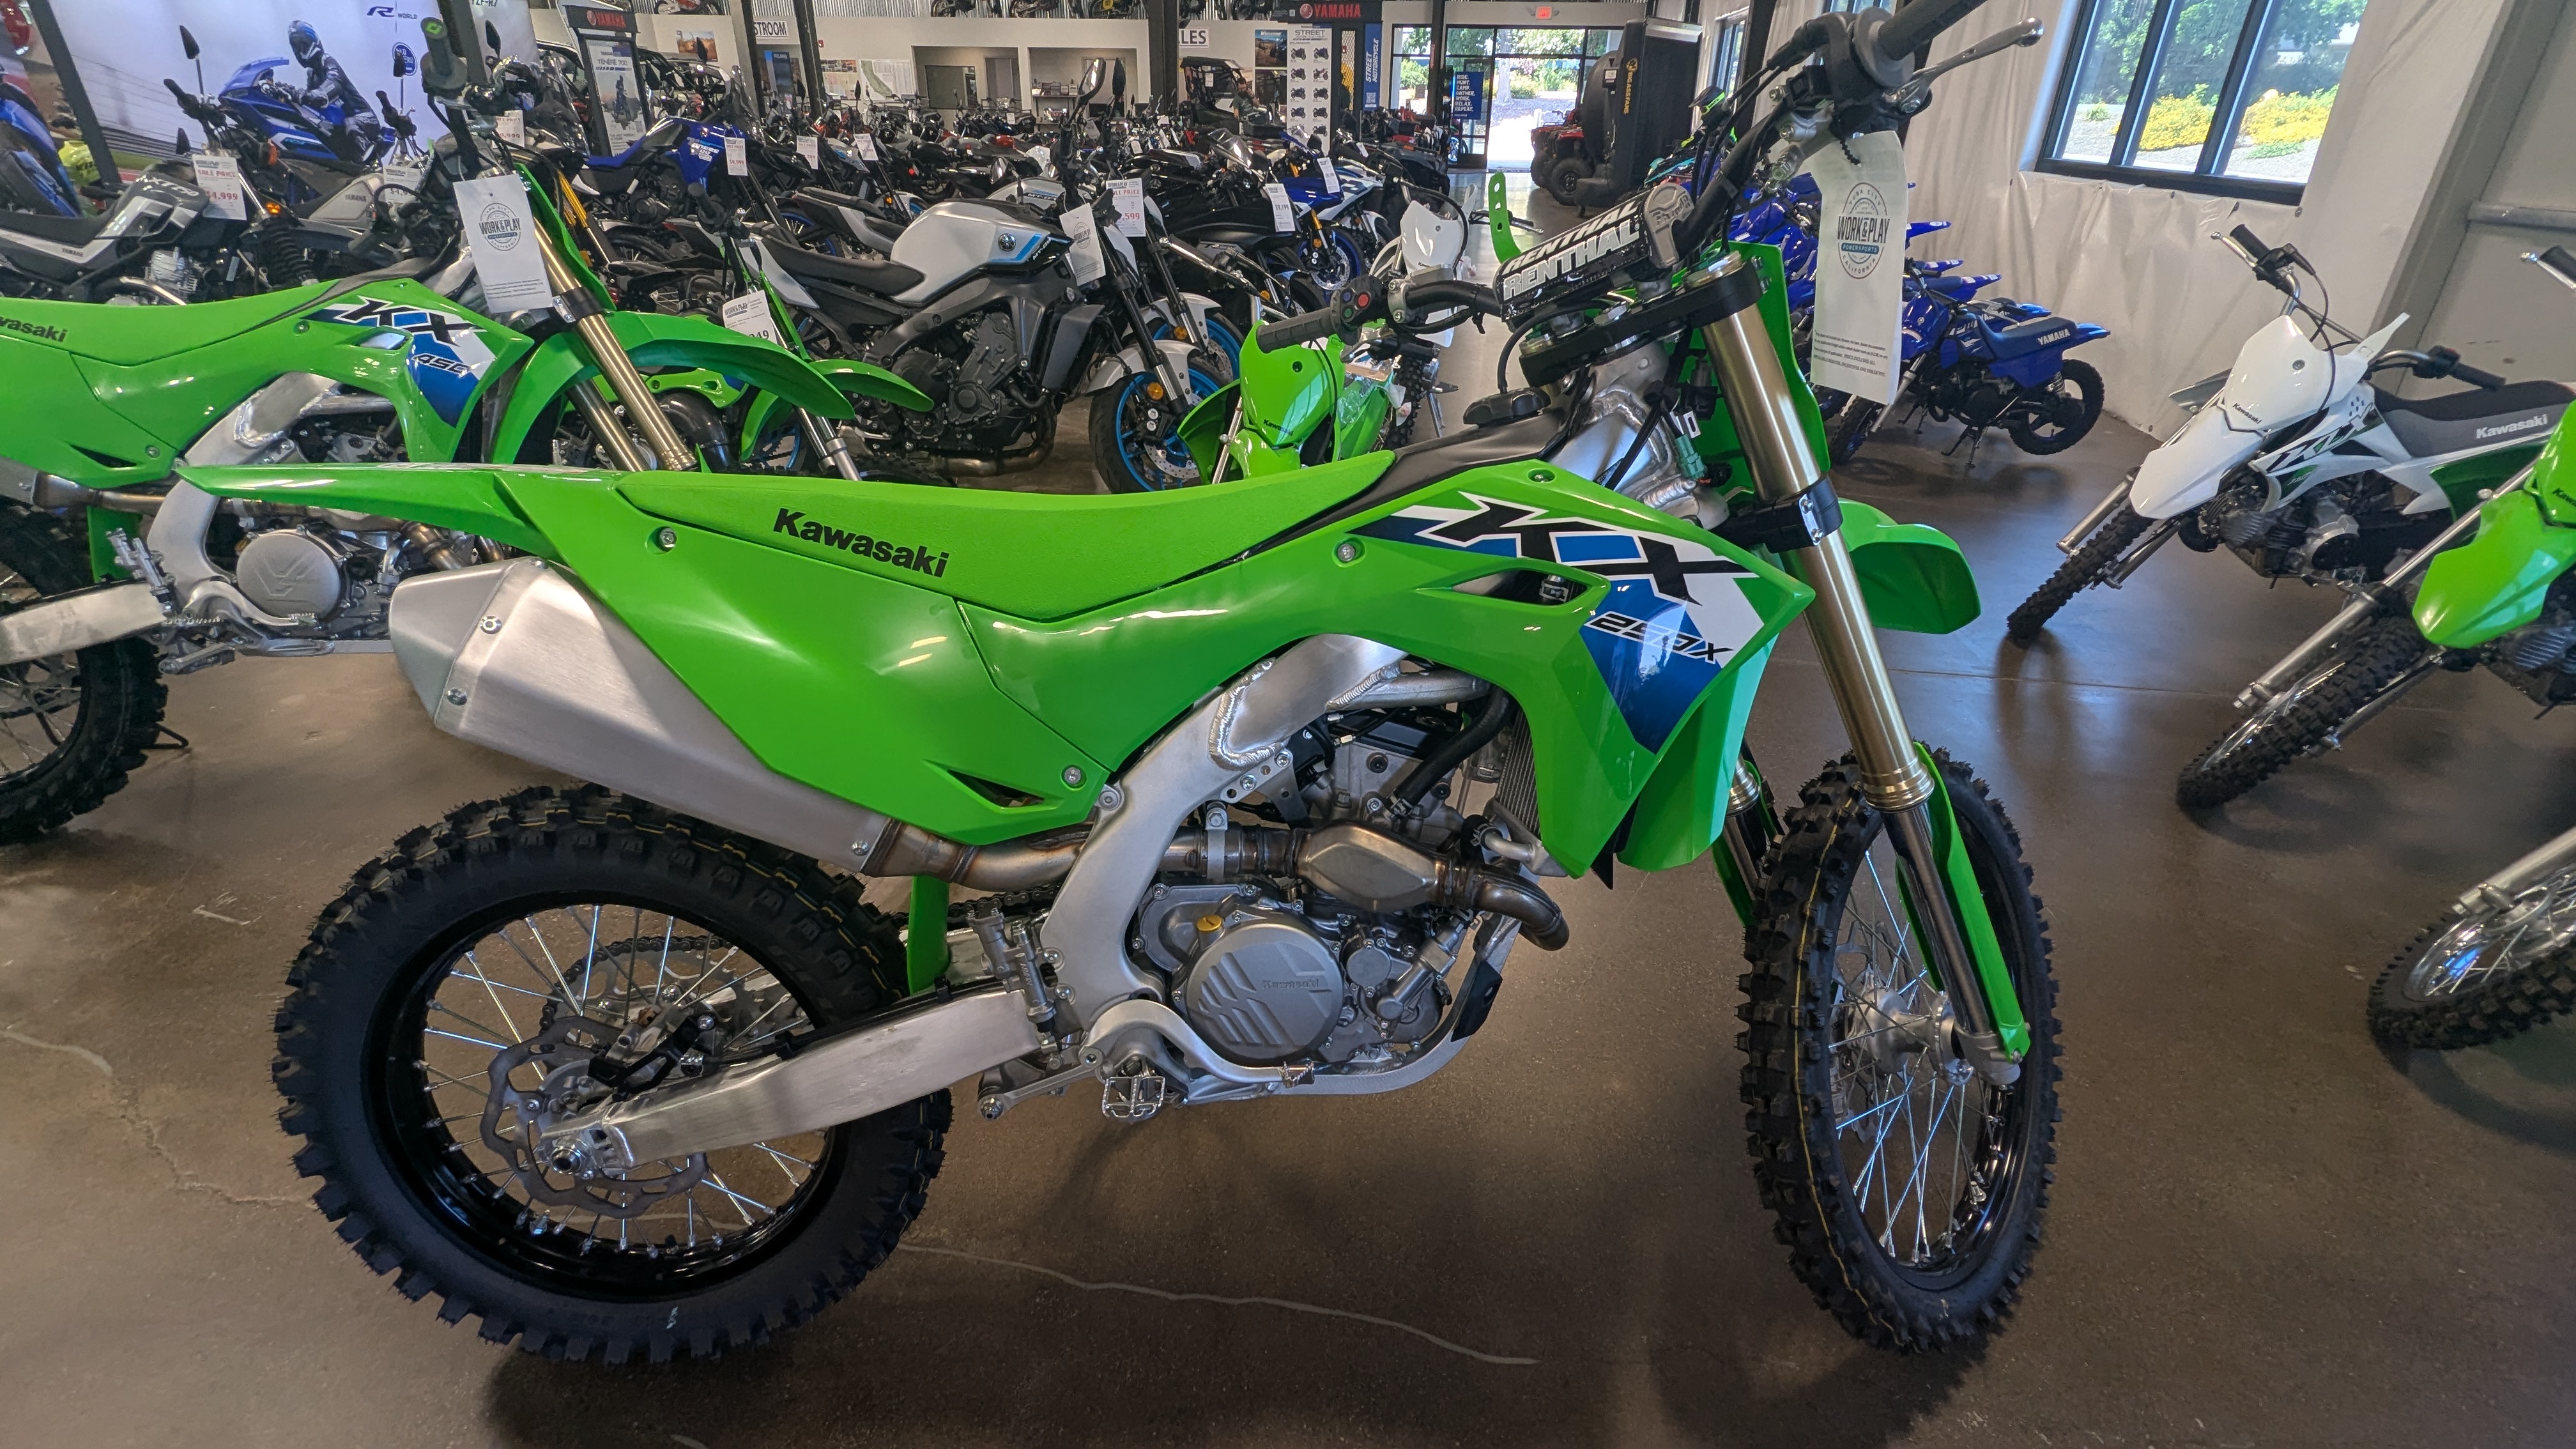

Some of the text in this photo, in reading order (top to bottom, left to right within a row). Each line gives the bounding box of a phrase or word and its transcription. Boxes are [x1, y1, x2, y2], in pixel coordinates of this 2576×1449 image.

[1314, 4, 1361, 18] YAMAHA
[1849, 189, 1882, 206] YUBA CITY
[1502, 201, 1639, 275] RENTHAL
[1837, 216, 1890, 243] WORK&PLAY
[1843, 243, 1878, 253] POWERSPORTS
[1503, 219, 1640, 301] RENTHAL
[1842, 254, 1876, 274] CALIFORNIA
[335, 295, 487, 347] KX
[2037, 328, 2070, 345] YAMAHA
[413, 353, 473, 376] 450
[2232, 402, 2263, 425] Kawasaki
[1263, 418, 1294, 437] Kawasaki
[2475, 413, 2548, 440] Kawasaki
[773, 507, 950, 578] Kawasaki
[1418, 493, 1759, 606] KX
[1586, 611, 1734, 663] 250X
[1262, 978, 1319, 989] Kawasaki
